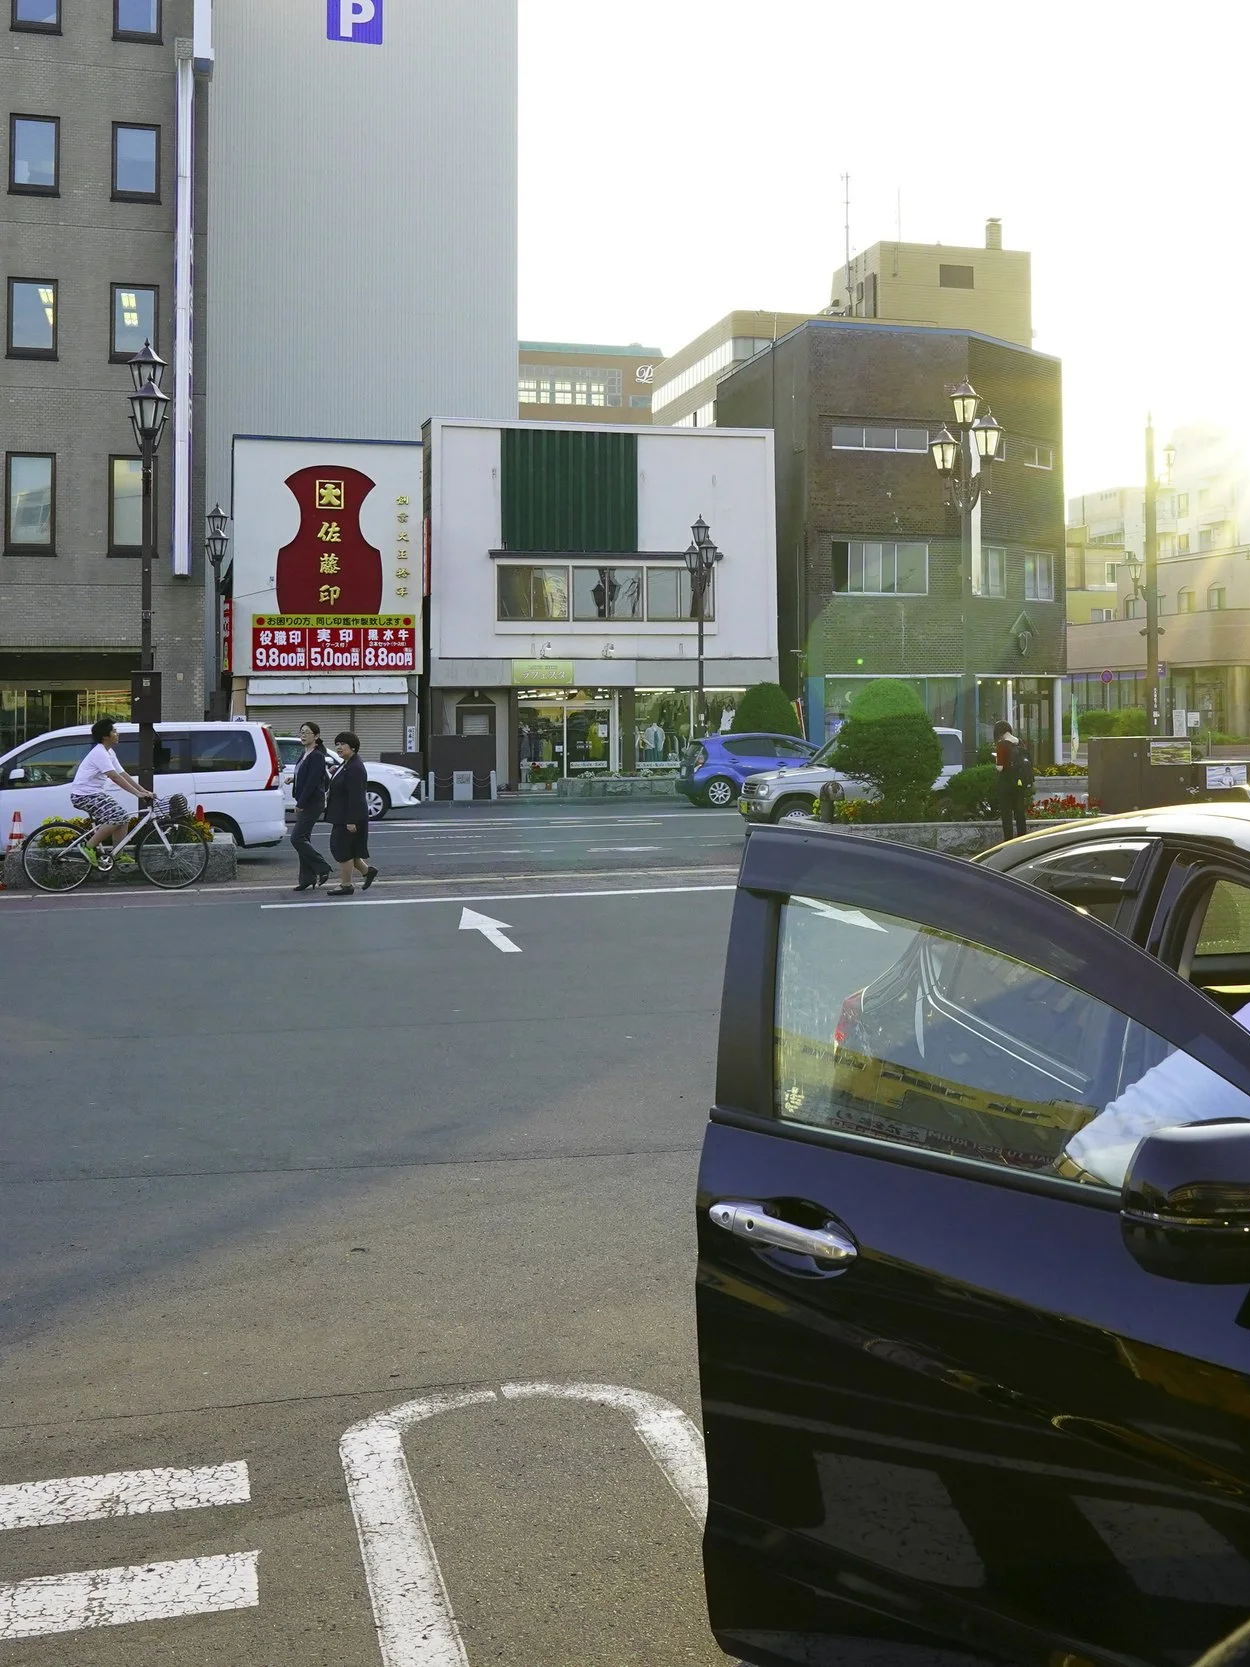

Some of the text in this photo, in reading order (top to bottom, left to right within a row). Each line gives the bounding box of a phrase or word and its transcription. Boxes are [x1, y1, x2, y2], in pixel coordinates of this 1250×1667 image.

[340, 0, 375, 38] P
[317, 521, 342, 606] 佐藤印
[259, 630, 302, 646] 役職印
[317, 629, 353, 643] 実印
[367, 629, 410, 641] 黒水牛
[255, 648, 305, 667] 9,800円
[311, 648, 360, 667] 5,000円
[365, 648, 413, 667] 8,800円
